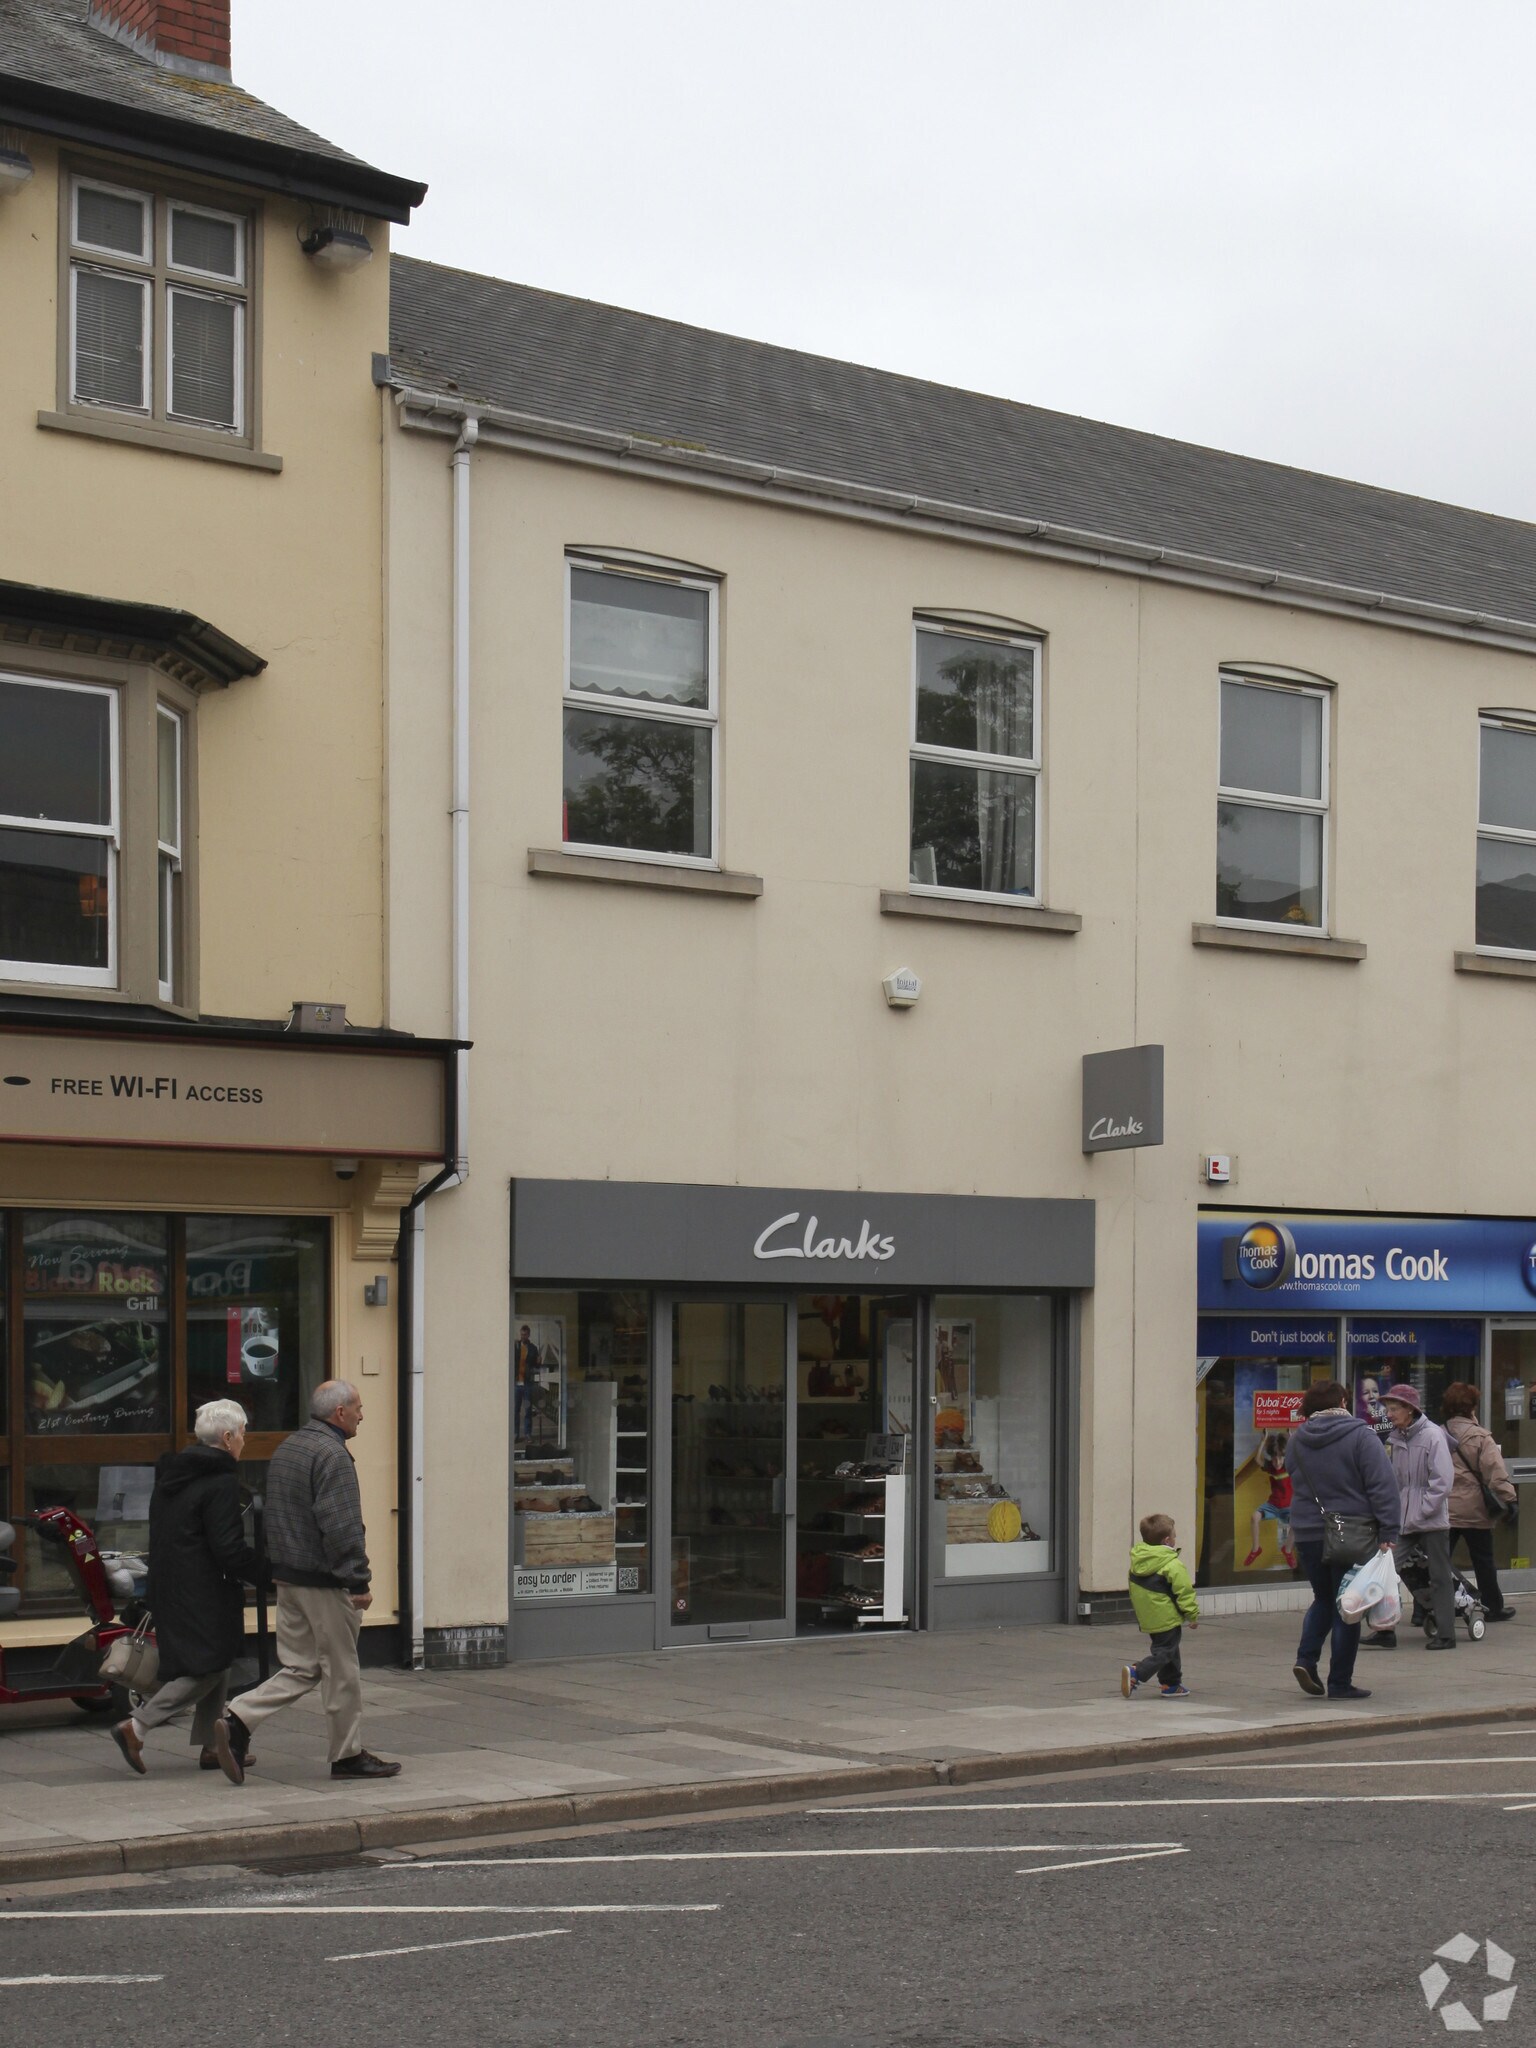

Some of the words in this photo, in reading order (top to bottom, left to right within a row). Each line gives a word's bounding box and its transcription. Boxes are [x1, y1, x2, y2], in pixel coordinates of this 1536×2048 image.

[51, 1078, 103, 1096] FREE
[109, 1074, 177, 1100] WI-FI
[185, 1085, 263, 1104] ACCESS
[1088, 1116, 1143, 1141] Clarks
[753, 1212, 895, 1260] Clarks
[1239, 1245, 1278, 1259] Thomas
[1250, 1256, 1278, 1269] Cook
[1294, 1252, 1375, 1280] omas
[1385, 1247, 1449, 1281] Cook
[98, 1271, 155, 1293] Rock
[1279, 1280, 1360, 1292] ww.thomascook.com
[126, 1296, 158, 1311] Grill
[1251, 1330, 1278, 1343] Don't
[1279, 1331, 1298, 1346] just
[1300, 1331, 1326, 1343] book
[1327, 1330, 1336, 1343] it.
[1381, 1331, 1407, 1343] Cook
[1408, 1331, 1417, 1343] it.
[1256, 1396, 1280, 1408] Dubai
[517, 1575, 538, 1588] easy
[539, 1573, 550, 1584] to
[551, 1571, 577, 1584] order
